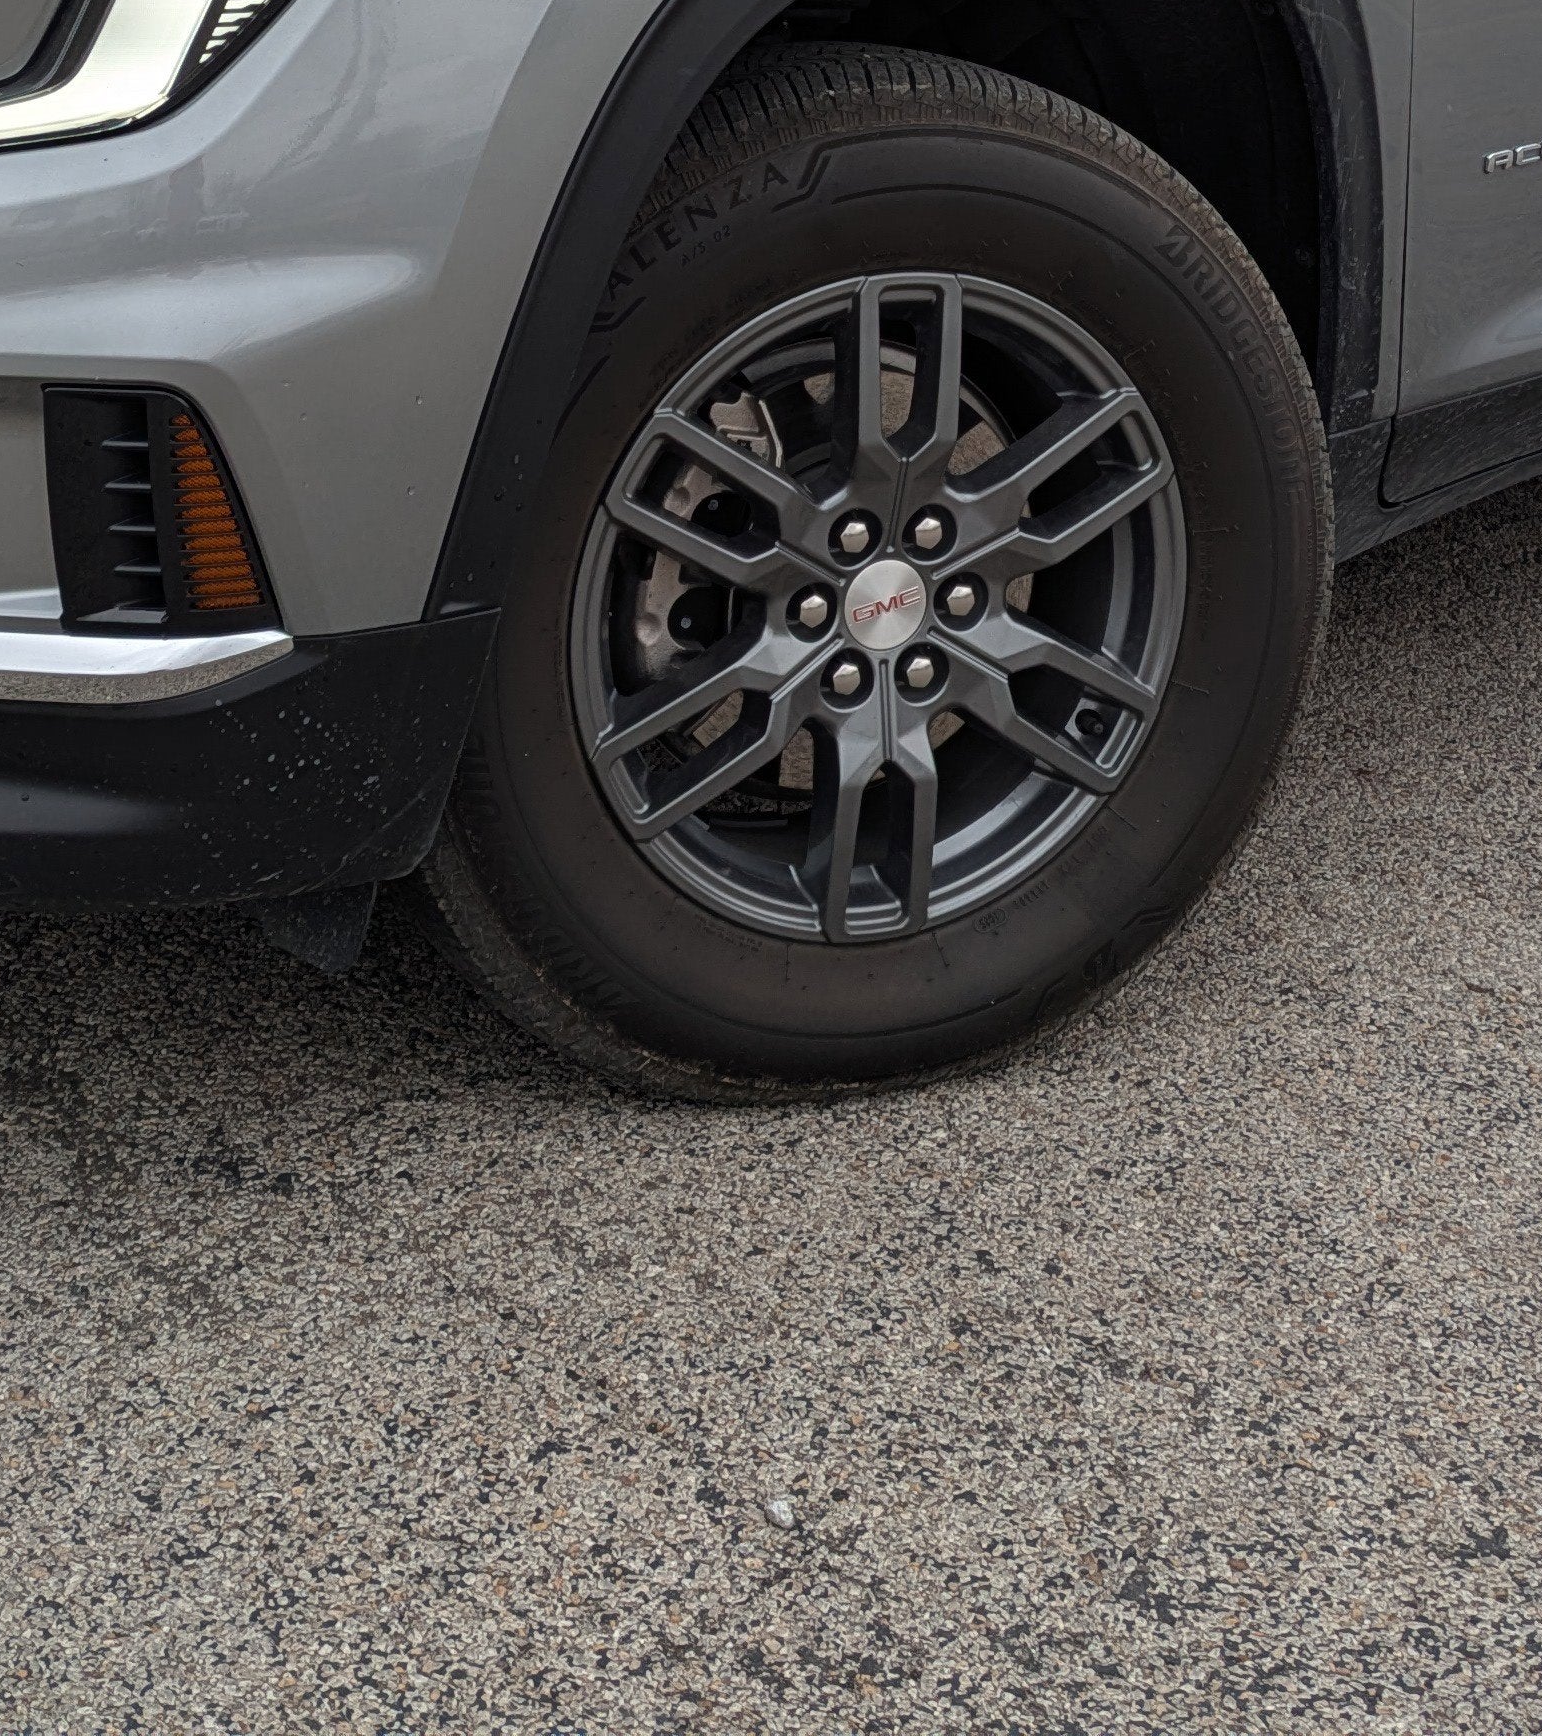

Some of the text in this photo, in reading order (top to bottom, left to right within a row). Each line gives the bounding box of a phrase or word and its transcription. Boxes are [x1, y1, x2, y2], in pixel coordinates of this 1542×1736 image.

[607, 162, 789, 302] ALENZA
[1150, 221, 1308, 503] BRIDGESTONE
[851, 585, 921, 623] GMC
